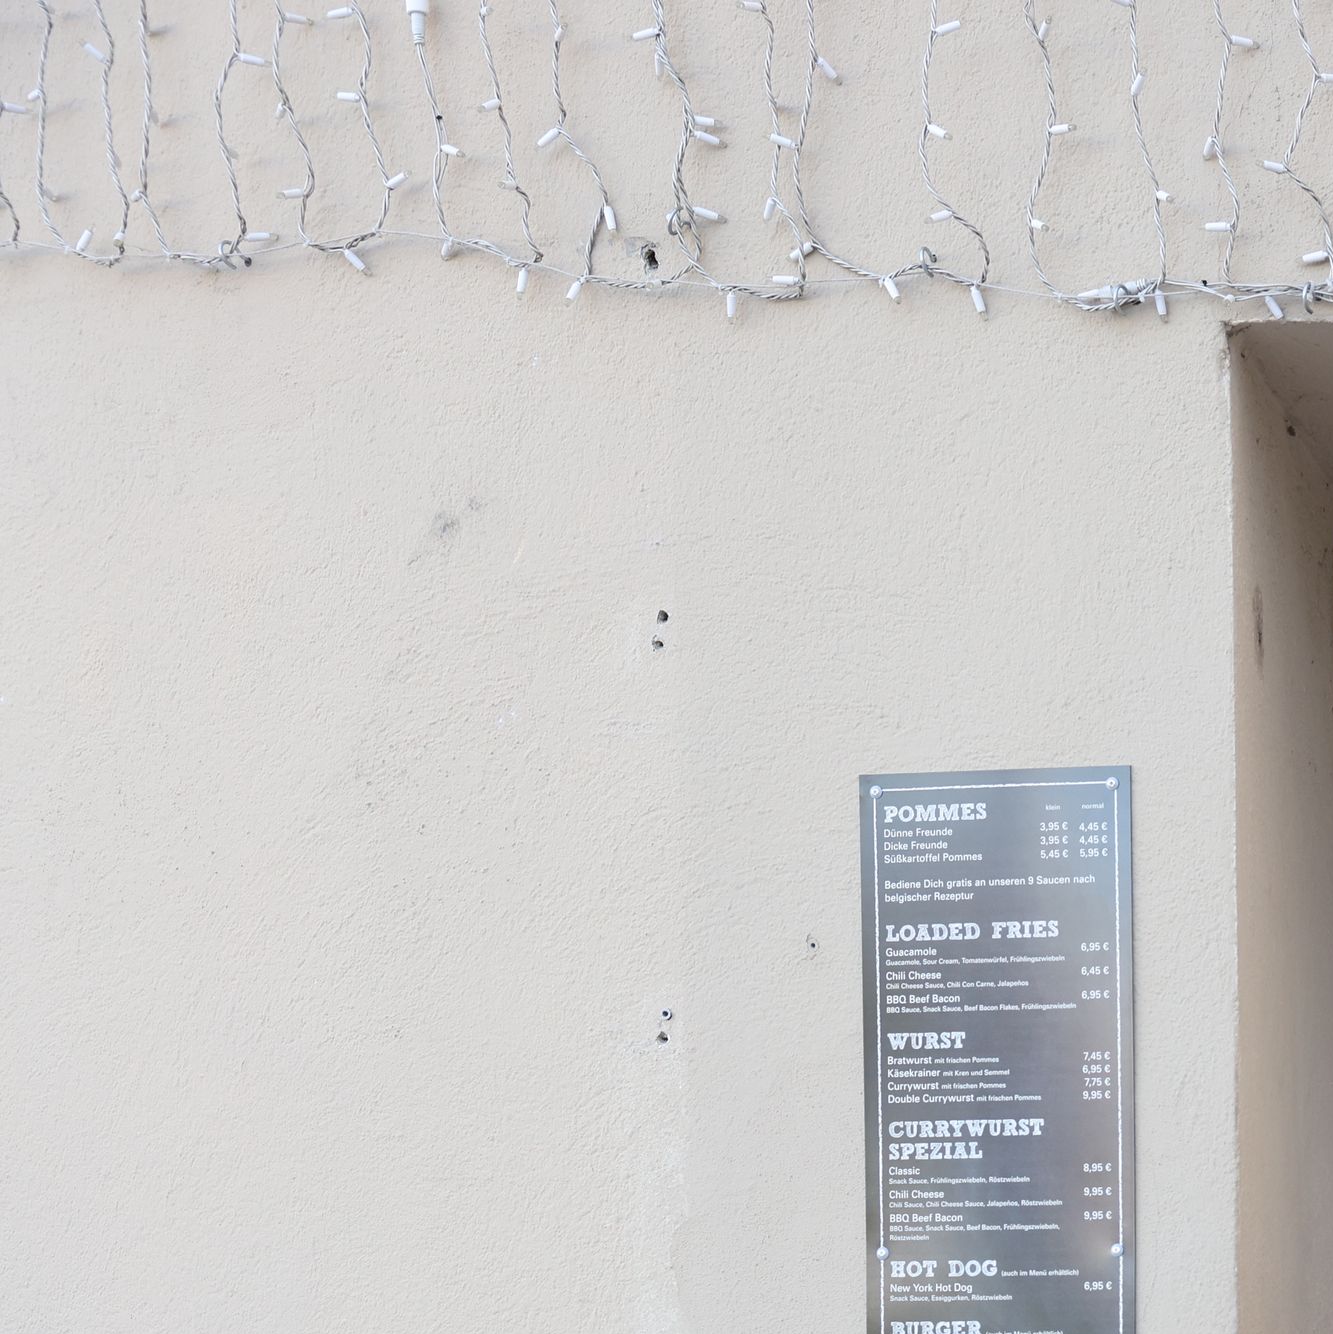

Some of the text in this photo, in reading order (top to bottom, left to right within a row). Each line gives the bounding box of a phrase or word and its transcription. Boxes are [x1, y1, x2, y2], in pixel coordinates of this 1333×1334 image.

[883, 802, 987, 823] POMMES
[884, 829, 913, 838] Dünne
[916, 827, 953, 837] Freunde
[1040, 822, 1059, 832] 3,95
[1079, 822, 1099, 832] 4,45
[884, 841, 908, 851] Dicke
[911, 840, 948, 850] Freunde
[1040, 835, 1060, 845] 3,95
[1079, 835, 1099, 845] 4,45
[884, 853, 940, 864] Süßkartoffel
[942, 852, 982, 862] Pommes
[1040, 849, 1060, 859] 5,45
[1080, 848, 1099, 858] 5,95
[885, 920, 1059, 942] LOADED FRIES
[886, 947, 937, 957] Guacamole
[1081, 942, 1101, 952] 6,95
[886, 971, 906, 980] Chili
[908, 971, 942, 980] Cheese
[1081, 966, 1101, 976] 6,45
[887, 1031, 966, 1050] WURST
[889, 1118, 1045, 1138] CURRYWURST
[889, 1141, 983, 1160] SPEZIAL
[890, 1259, 997, 1278] HOT DOG
[890, 1284, 911, 1292] New
[913, 1283, 933, 1292] York
[935, 1283, 952, 1292] Hot
[954, 1283, 973, 1294] Dog
[1084, 1281, 1104, 1292] 6,95
